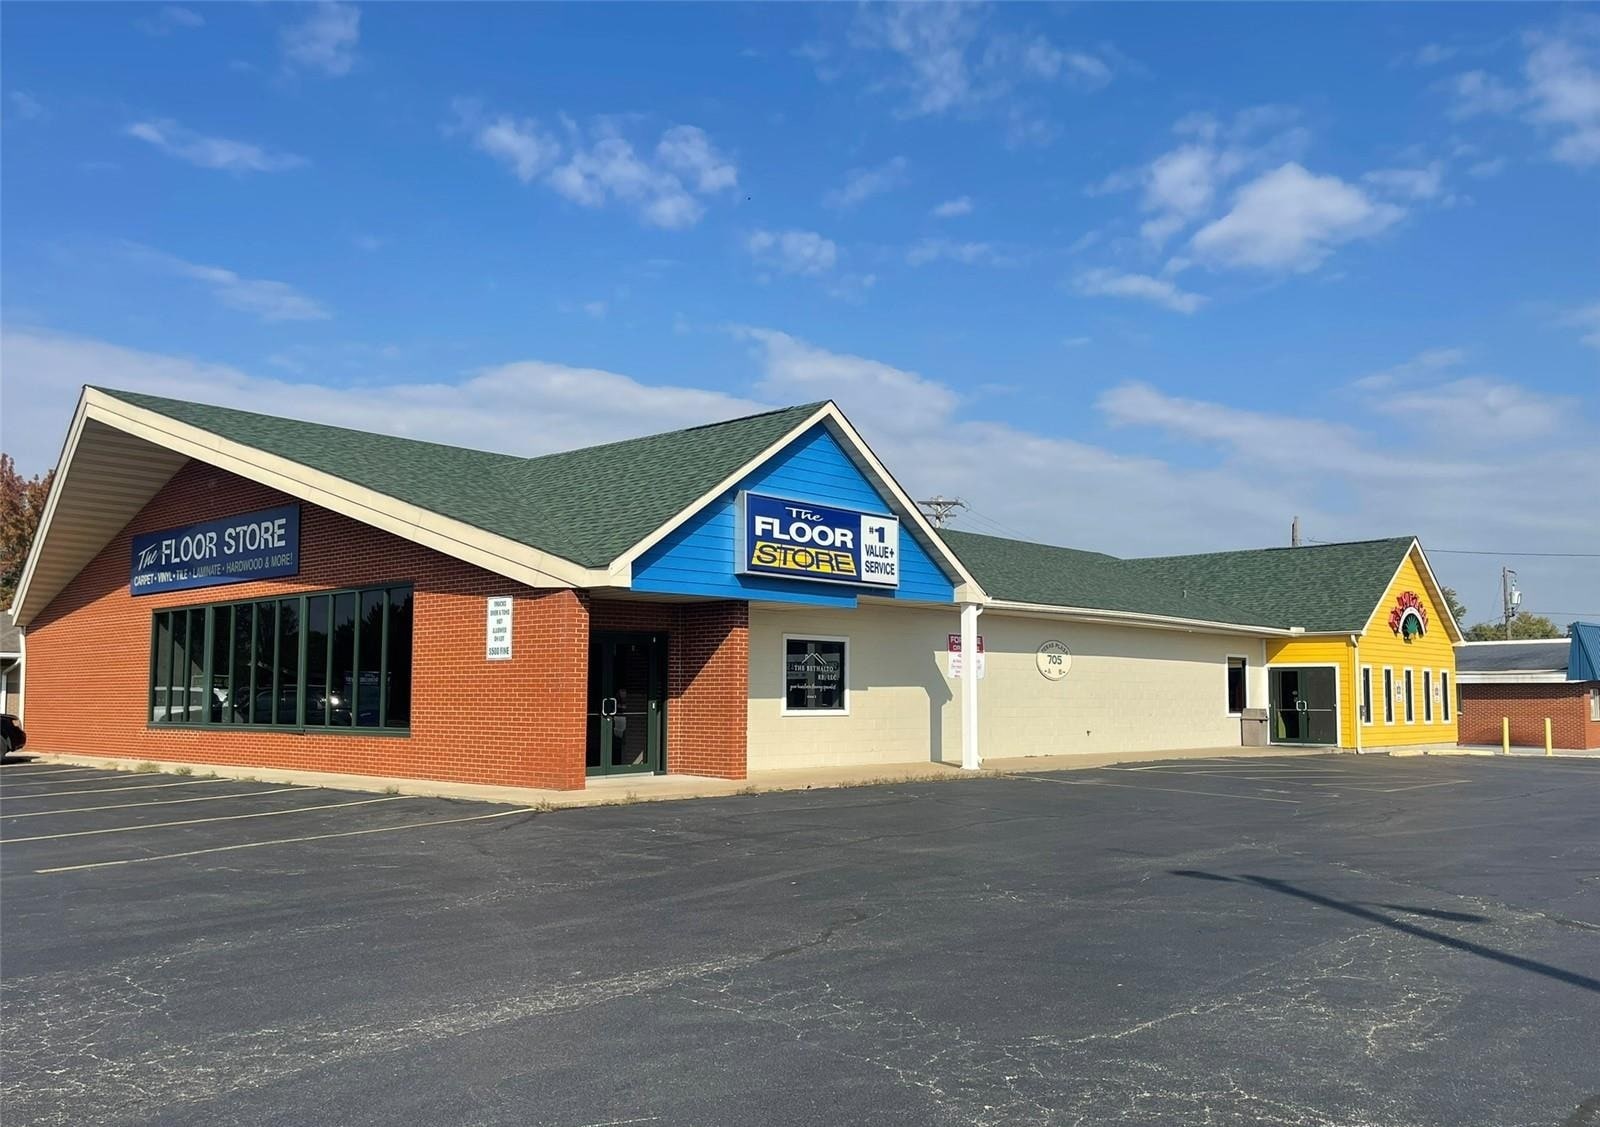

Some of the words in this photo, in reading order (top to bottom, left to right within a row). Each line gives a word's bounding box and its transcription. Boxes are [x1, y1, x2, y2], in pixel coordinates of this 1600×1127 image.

[785, 507, 824, 522] The
[754, 515, 854, 549] FLOOR
[868, 526, 885, 543] #1
[138, 543, 158, 571] The
[161, 531, 217, 565] FLOOR
[223, 518, 287, 554] STORE
[756, 543, 855, 574] STORE
[865, 560, 895, 576] SERVICE
[1047, 654, 1062, 665] 705
